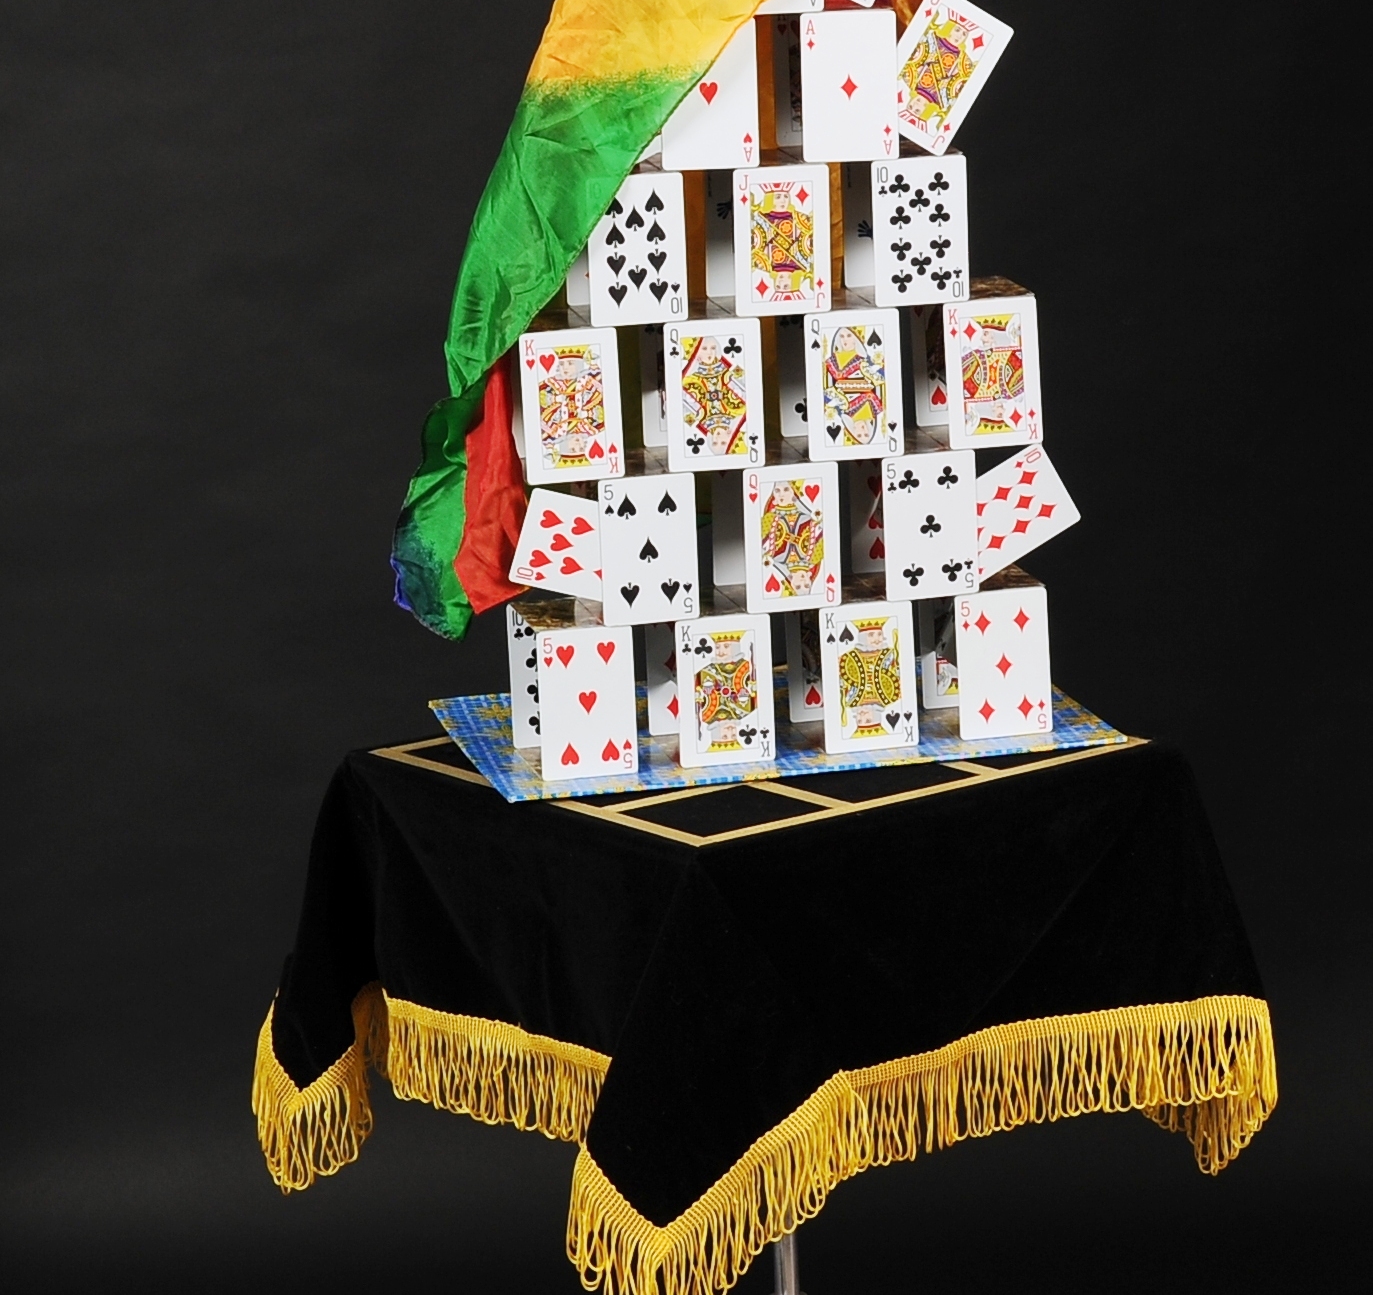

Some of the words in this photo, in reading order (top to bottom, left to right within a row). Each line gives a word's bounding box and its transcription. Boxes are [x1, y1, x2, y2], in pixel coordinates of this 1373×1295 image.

[806, 20, 815, 35] A
[883, 140, 892, 155] A
[932, 134, 946, 149] J
[744, 147, 752, 162] A
[739, 175, 748, 191] J
[877, 167, 888, 183] 10
[953, 281, 964, 298] 10
[671, 297, 682, 314] 10
[816, 292, 825, 308] J
[948, 309, 958, 325] K
[811, 319, 819, 335] Q
[670, 329, 679, 344] Q
[525, 339, 534, 356] K
[1028, 423, 1038, 439] K
[889, 436, 897, 452] Q
[749, 447, 758, 463] Q
[1024, 447, 1042, 463] 10
[609, 457, 618, 473] K
[887, 463, 896, 479] 5
[749, 474, 757, 490] Q
[604, 484, 613, 500] 5
[516, 567, 534, 581] 10
[965, 573, 974, 588] 5
[827, 587, 834, 602] Q
[684, 597, 693, 613] 5
[961, 601, 970, 617] 5
[826, 613, 834, 629] K
[681, 626, 691, 642] K
[543, 638, 553, 654] 5
[1038, 713, 1046, 729] 5
[905, 726, 913, 742] K
[761, 741, 770, 757] K
[623, 753, 632, 769] 5
